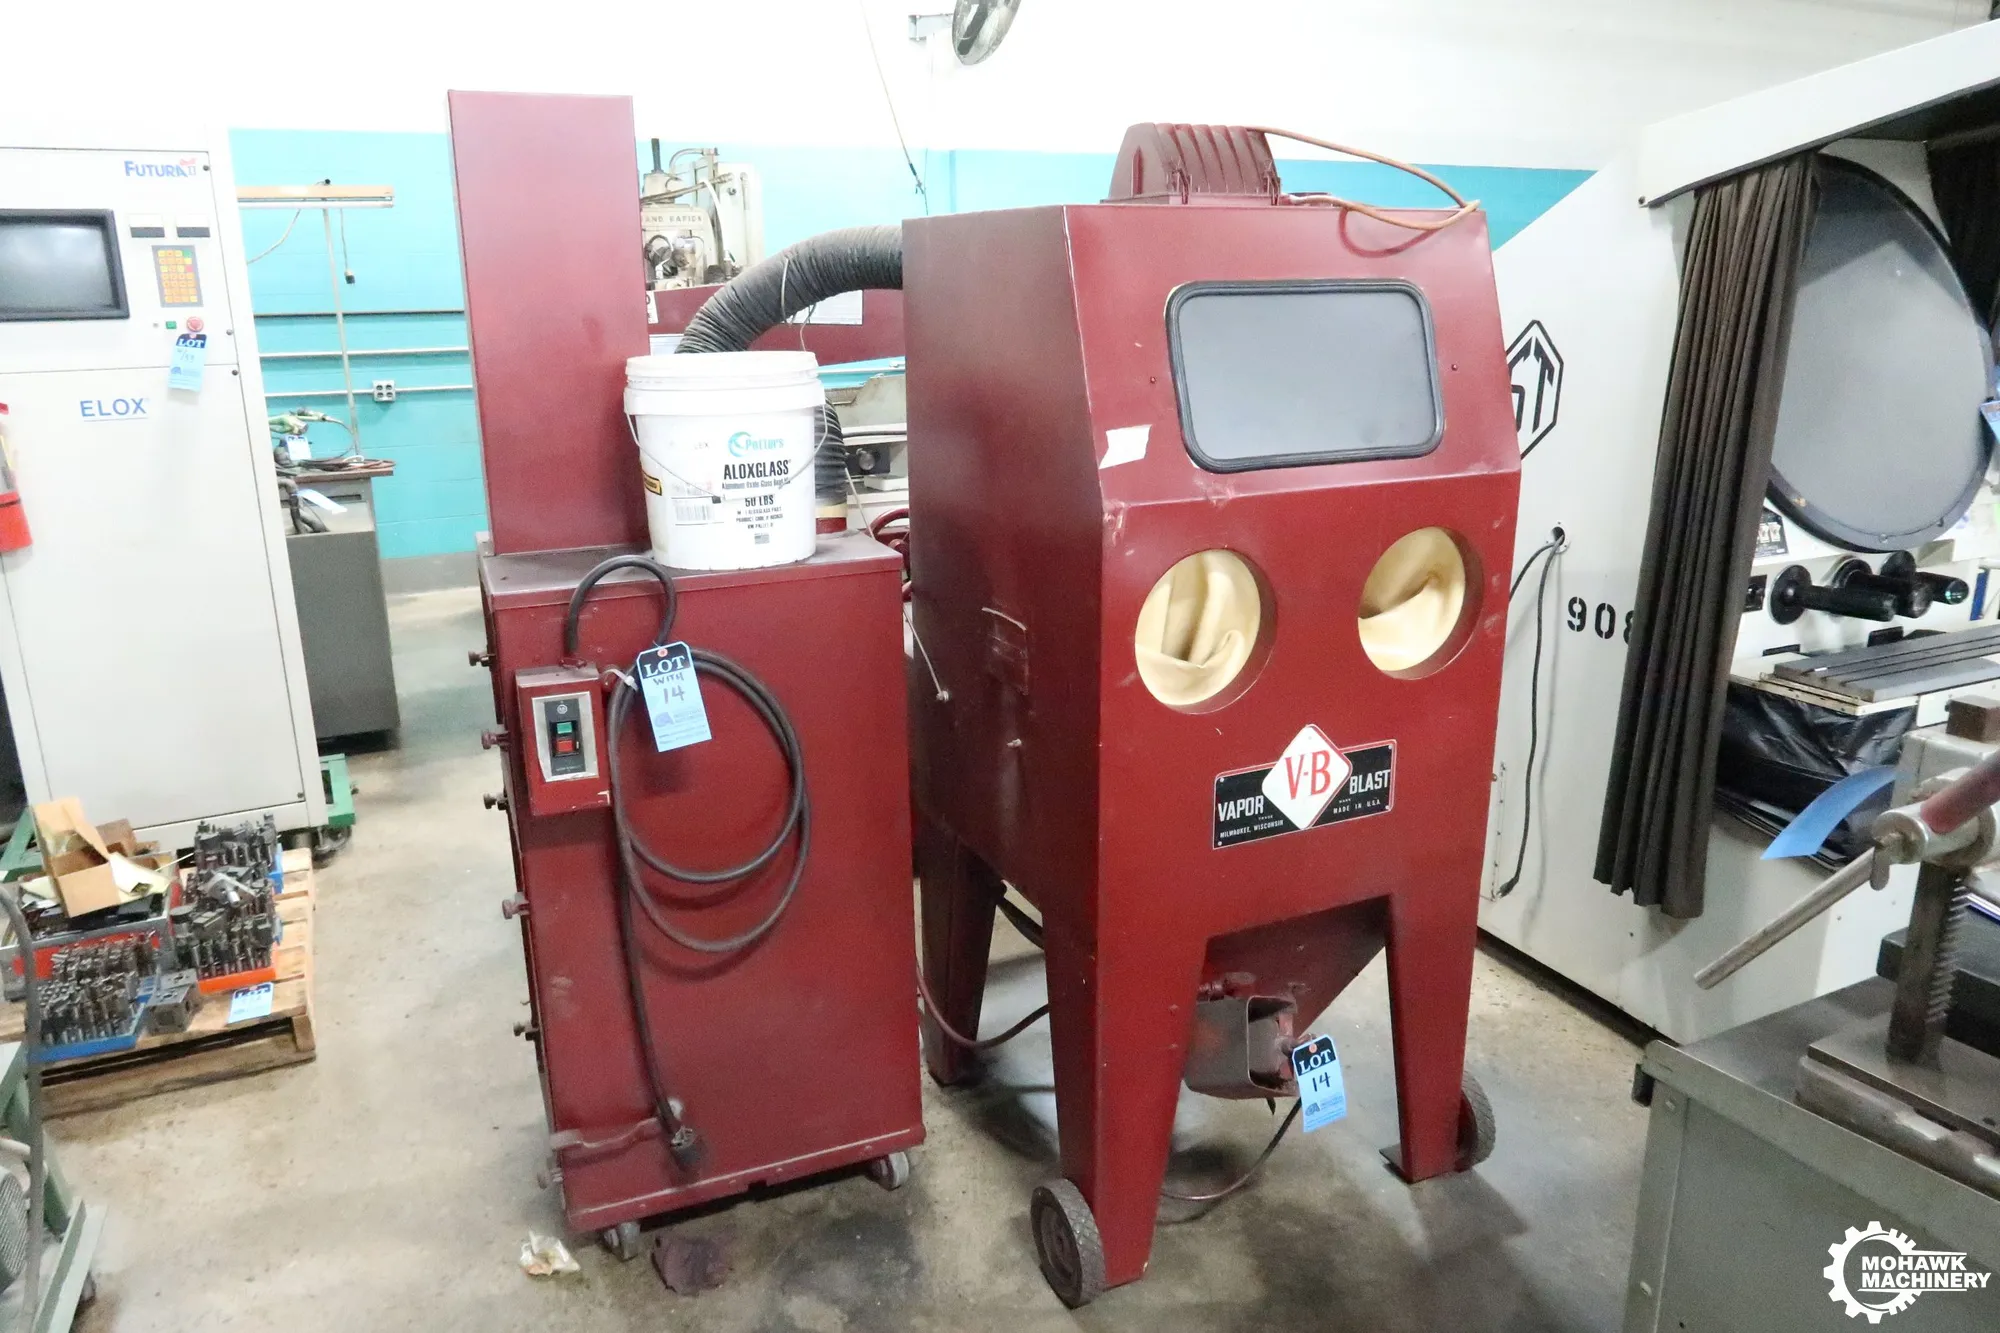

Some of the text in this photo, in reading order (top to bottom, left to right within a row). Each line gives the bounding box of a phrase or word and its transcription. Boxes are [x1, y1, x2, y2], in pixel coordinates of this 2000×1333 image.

[124, 160, 188, 177] FUTURA
[178, 338, 205, 348] LOT
[80, 398, 146, 417] ELOX
[723, 459, 789, 480] ALOXGLASS
[745, 494, 774, 507] 50 LBS
[644, 655, 685, 677] LOT
[652, 672, 685, 686] WITH
[663, 685, 685, 705] 14
[1284, 749, 1331, 800] V-B
[1349, 769, 1391, 795] BLAST
[1218, 795, 1264, 821] VAPOR
[1333, 805, 1351, 814] MADE
[1354, 802, 1363, 810] IN
[1220, 819, 1283, 838] MILWAUKEE, WISCONSIN
[1299, 1049, 1332, 1073] LOT
[1312, 1072, 1331, 1092] 14
